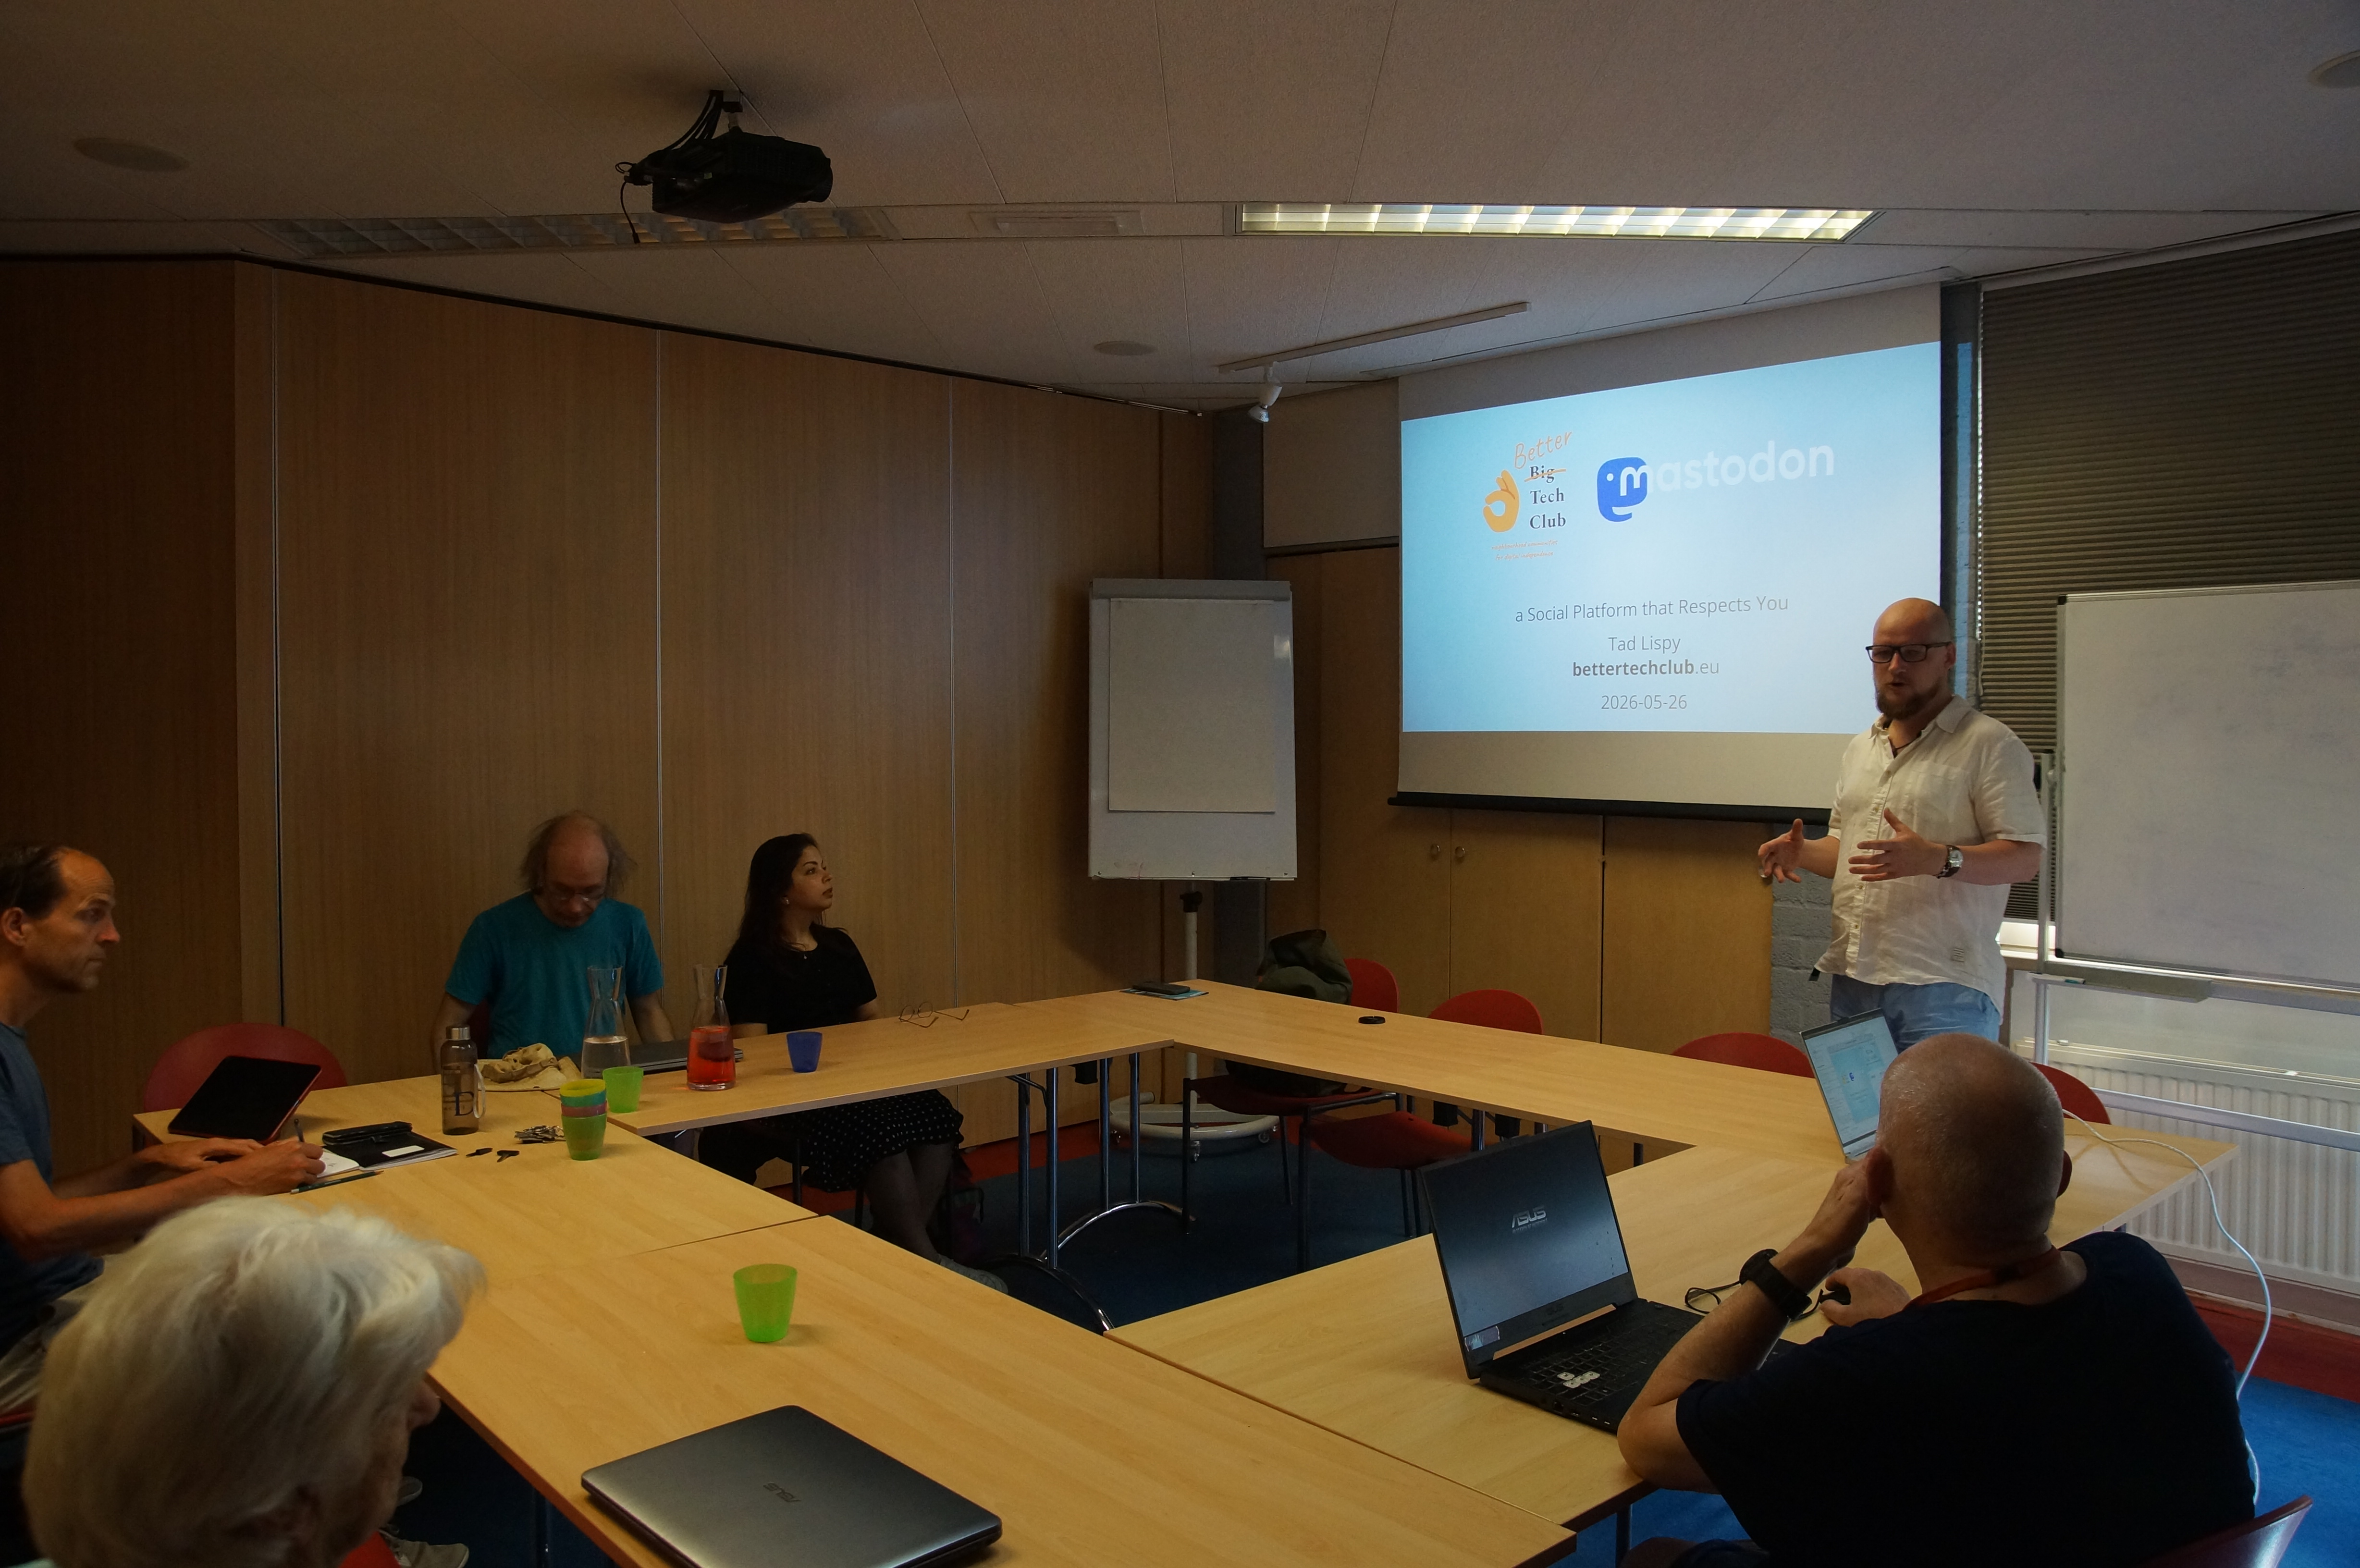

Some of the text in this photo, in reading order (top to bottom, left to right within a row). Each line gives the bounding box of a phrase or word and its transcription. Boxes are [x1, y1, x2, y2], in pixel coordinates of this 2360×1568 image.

[1514, 431, 1573, 469] Better
[1530, 465, 1555, 483] Big
[1620, 440, 1834, 496] mastodon
[1530, 487, 1564, 504] Tech
[1530, 512, 1566, 529] Club
[1515, 595, 1789, 622] a Social Platform that Respects You
[1608, 636, 1681, 654] Tad Lispy
[1573, 659, 1720, 676] bettertechclub.eu
[1601, 694, 1687, 710] 2026-05-26
[1511, 1205, 1547, 1228] ASUS
